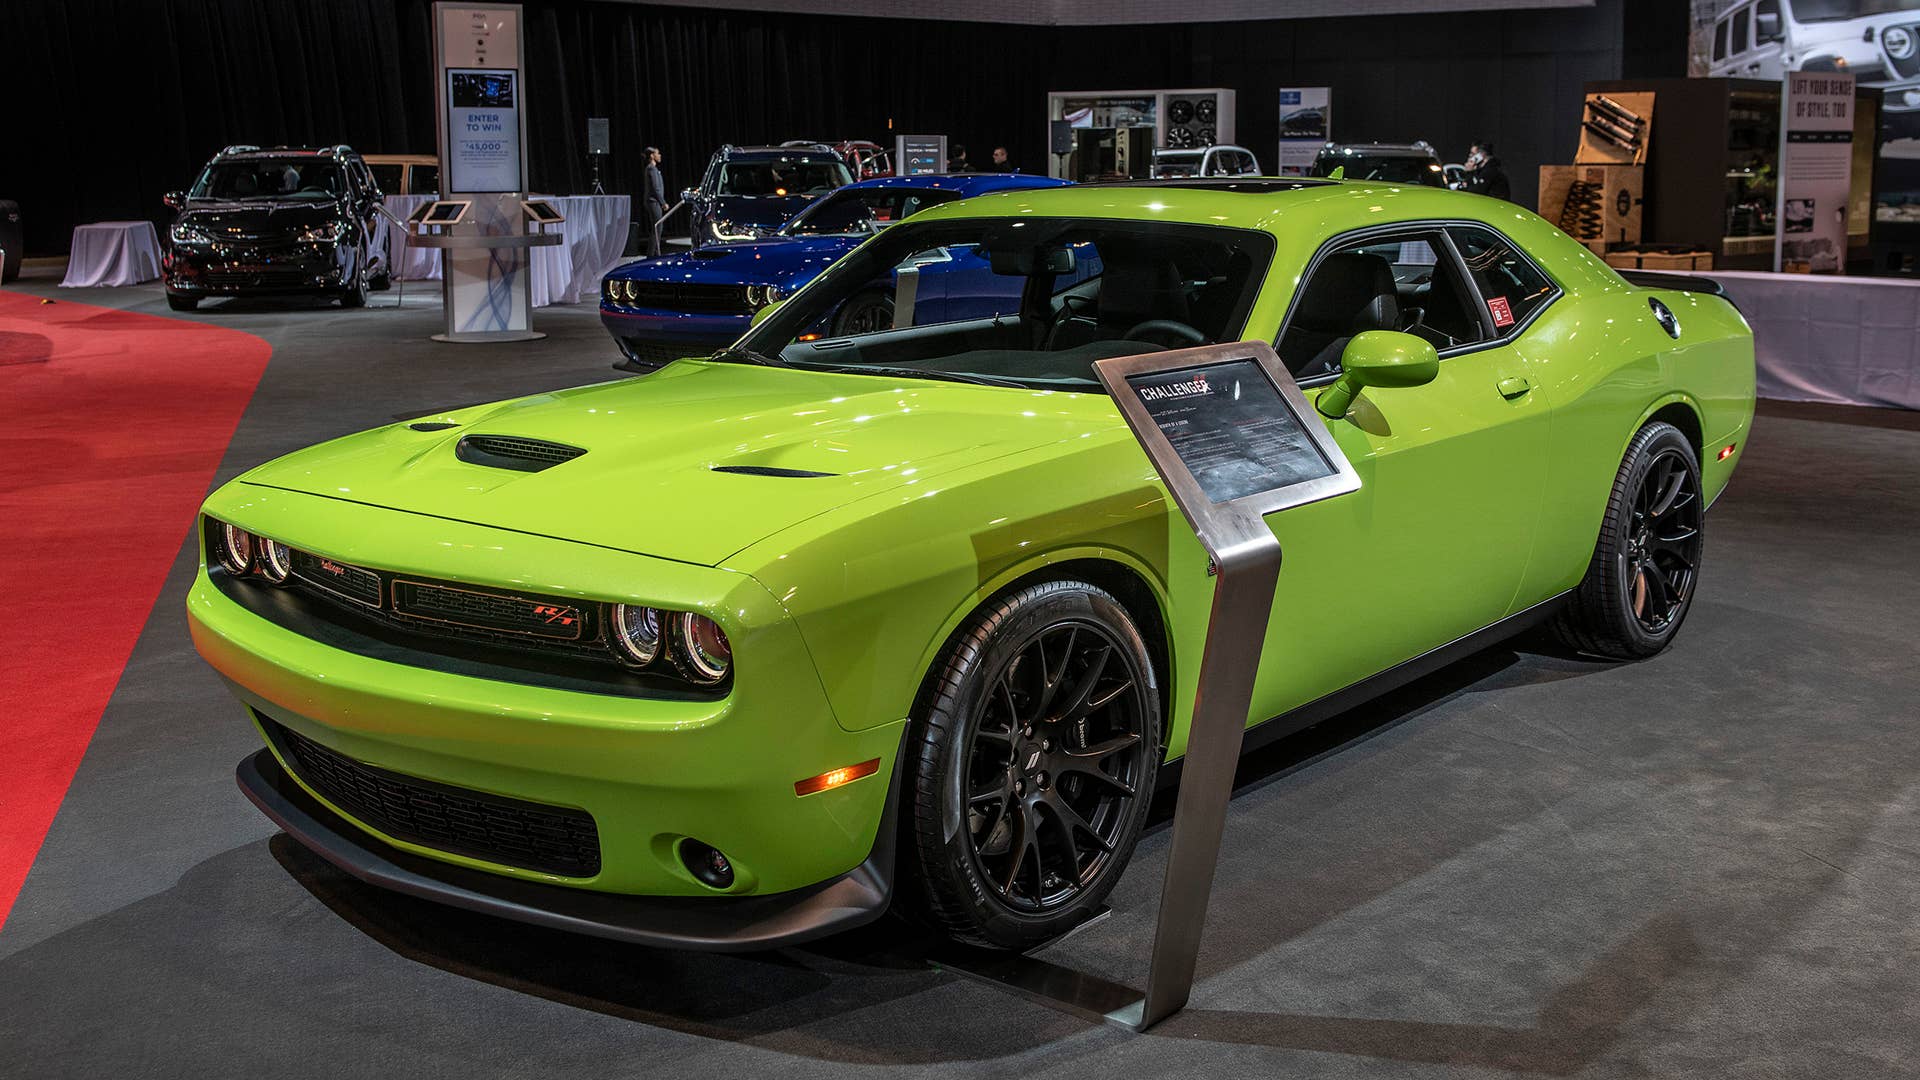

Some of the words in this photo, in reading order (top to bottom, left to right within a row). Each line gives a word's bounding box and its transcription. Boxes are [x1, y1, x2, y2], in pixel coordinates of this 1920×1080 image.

[1792, 79, 1807, 94] LIFT
[1810, 79, 1828, 95] YOUR
[1797, 102, 1806, 117] OF
[1832, 102, 1847, 117] TOO
[468, 114, 499, 122] ENTER
[1140, 380, 1211, 400] CHALLENGER
[533, 605, 578, 625] R/T
